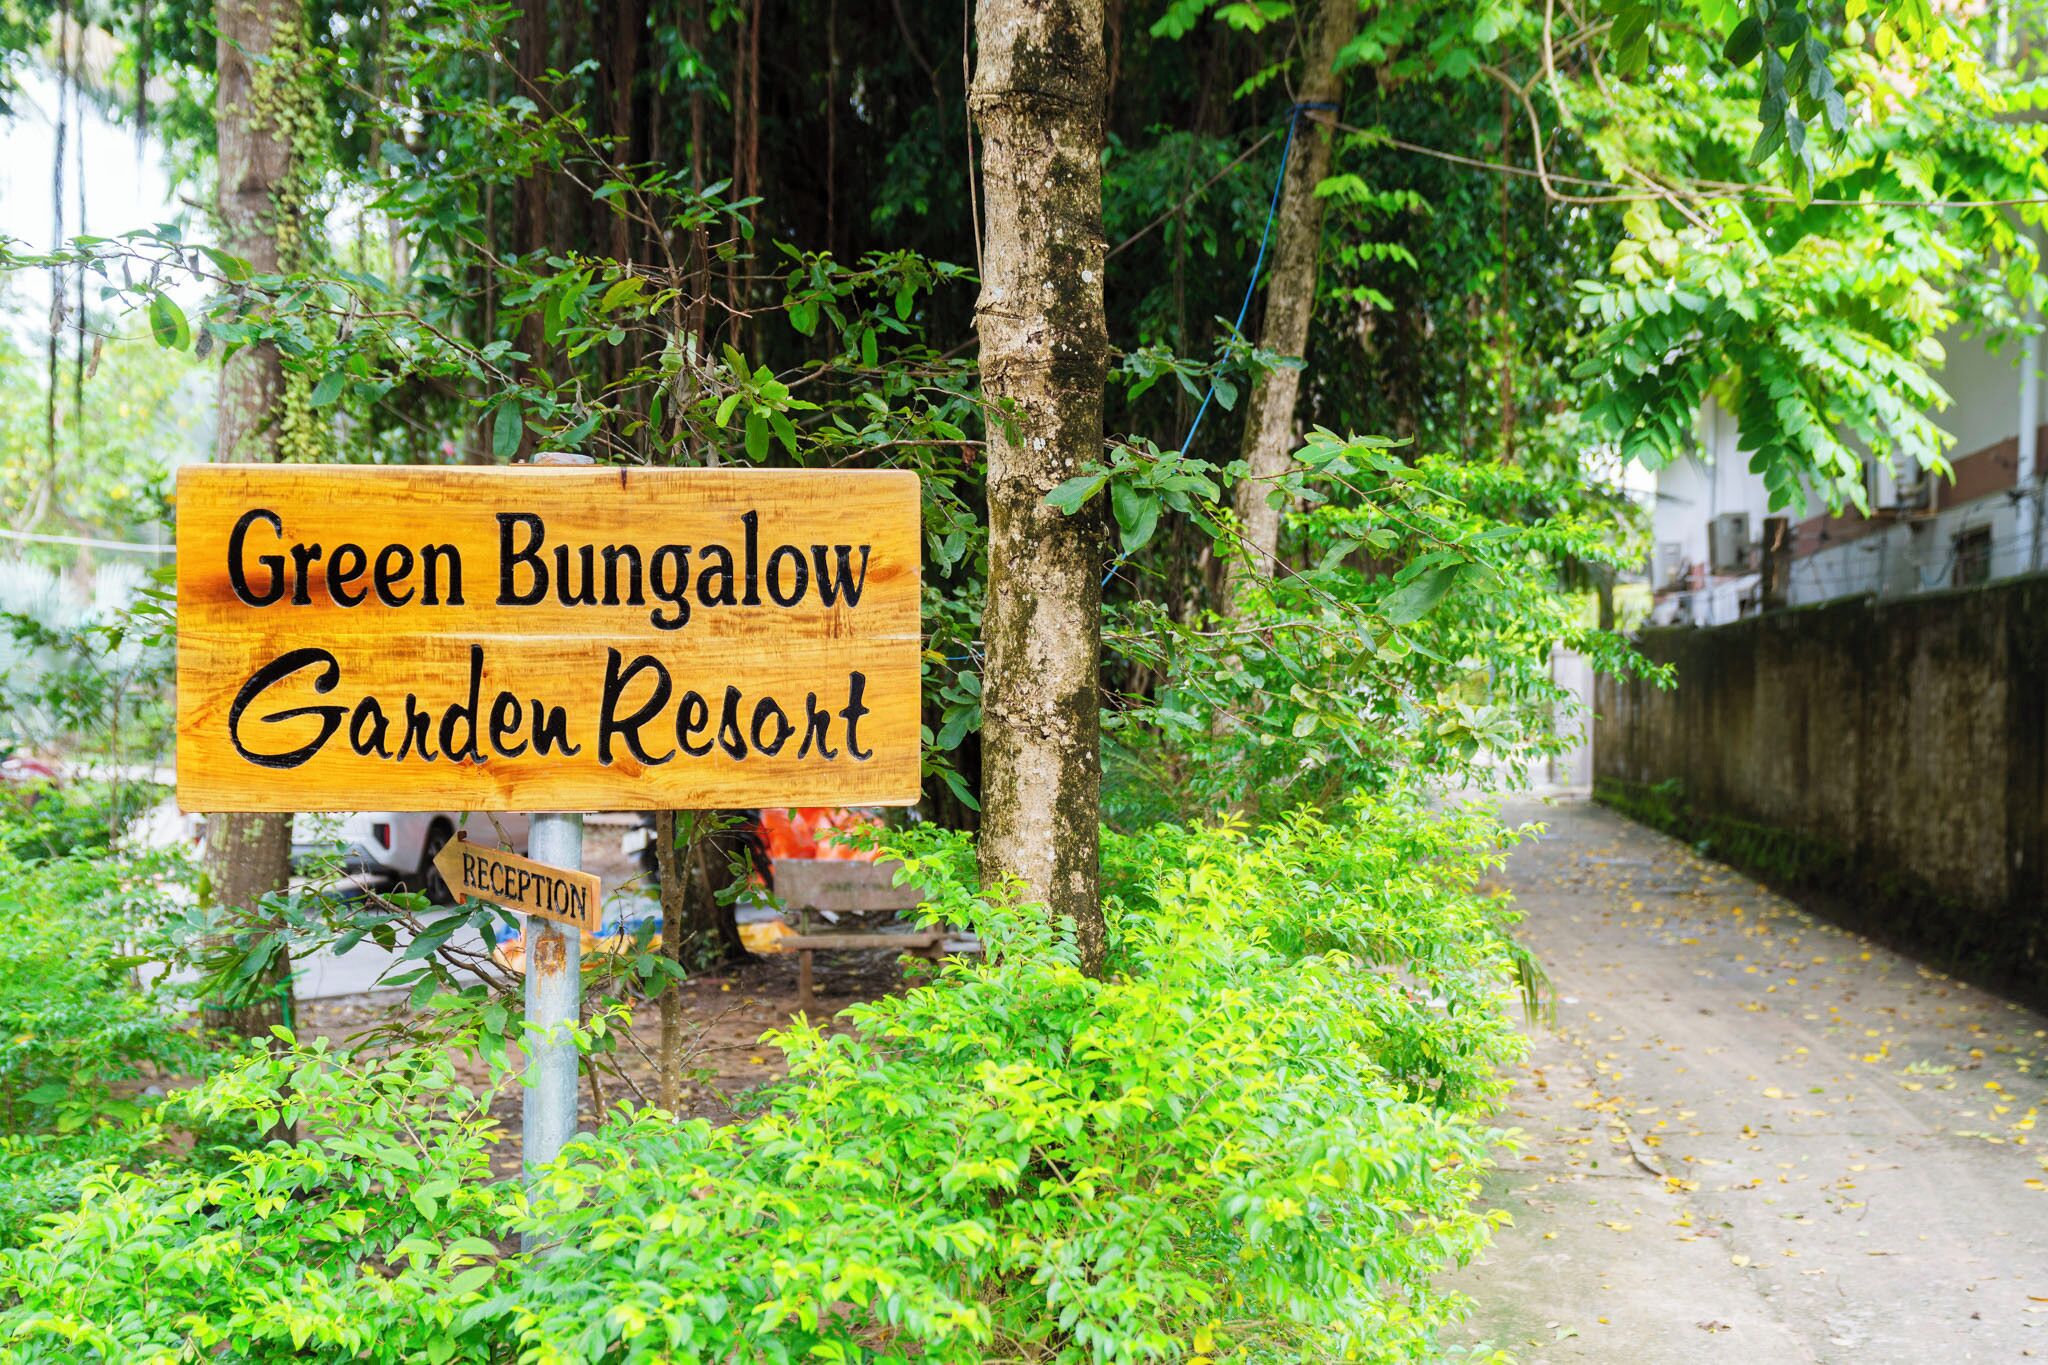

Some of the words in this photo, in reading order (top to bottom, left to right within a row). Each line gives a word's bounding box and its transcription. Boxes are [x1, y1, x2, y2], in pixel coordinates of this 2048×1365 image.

[228, 509, 464, 608] Green
[496, 509, 872, 630] Bungalow
[228, 643, 581, 769] Garden
[598, 646, 873, 765] Resort
[462, 853, 587, 921] RECEPTION
